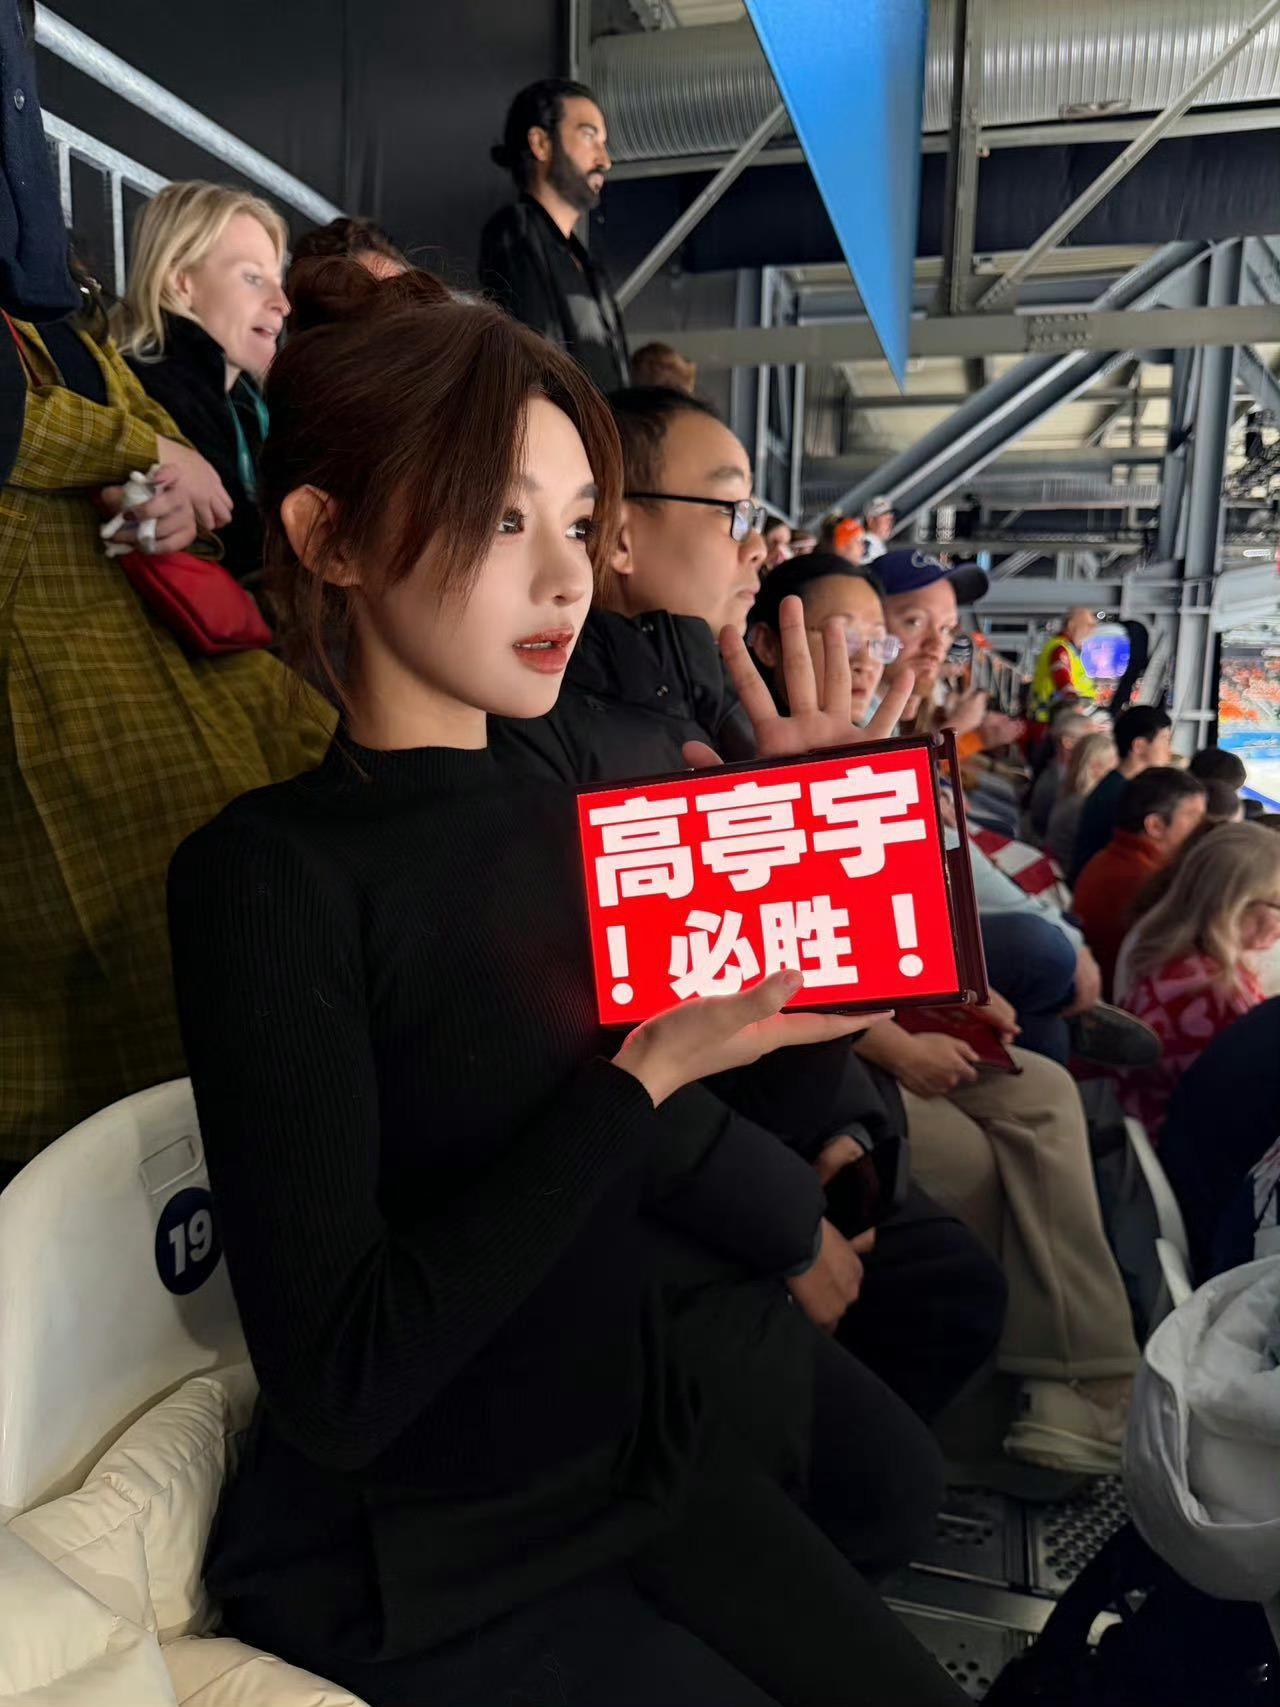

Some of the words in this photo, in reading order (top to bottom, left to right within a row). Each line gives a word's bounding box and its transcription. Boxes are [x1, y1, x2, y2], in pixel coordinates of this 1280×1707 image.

[589, 765, 927, 907] 高亭宇
[168, 1208, 213, 1277] 19
